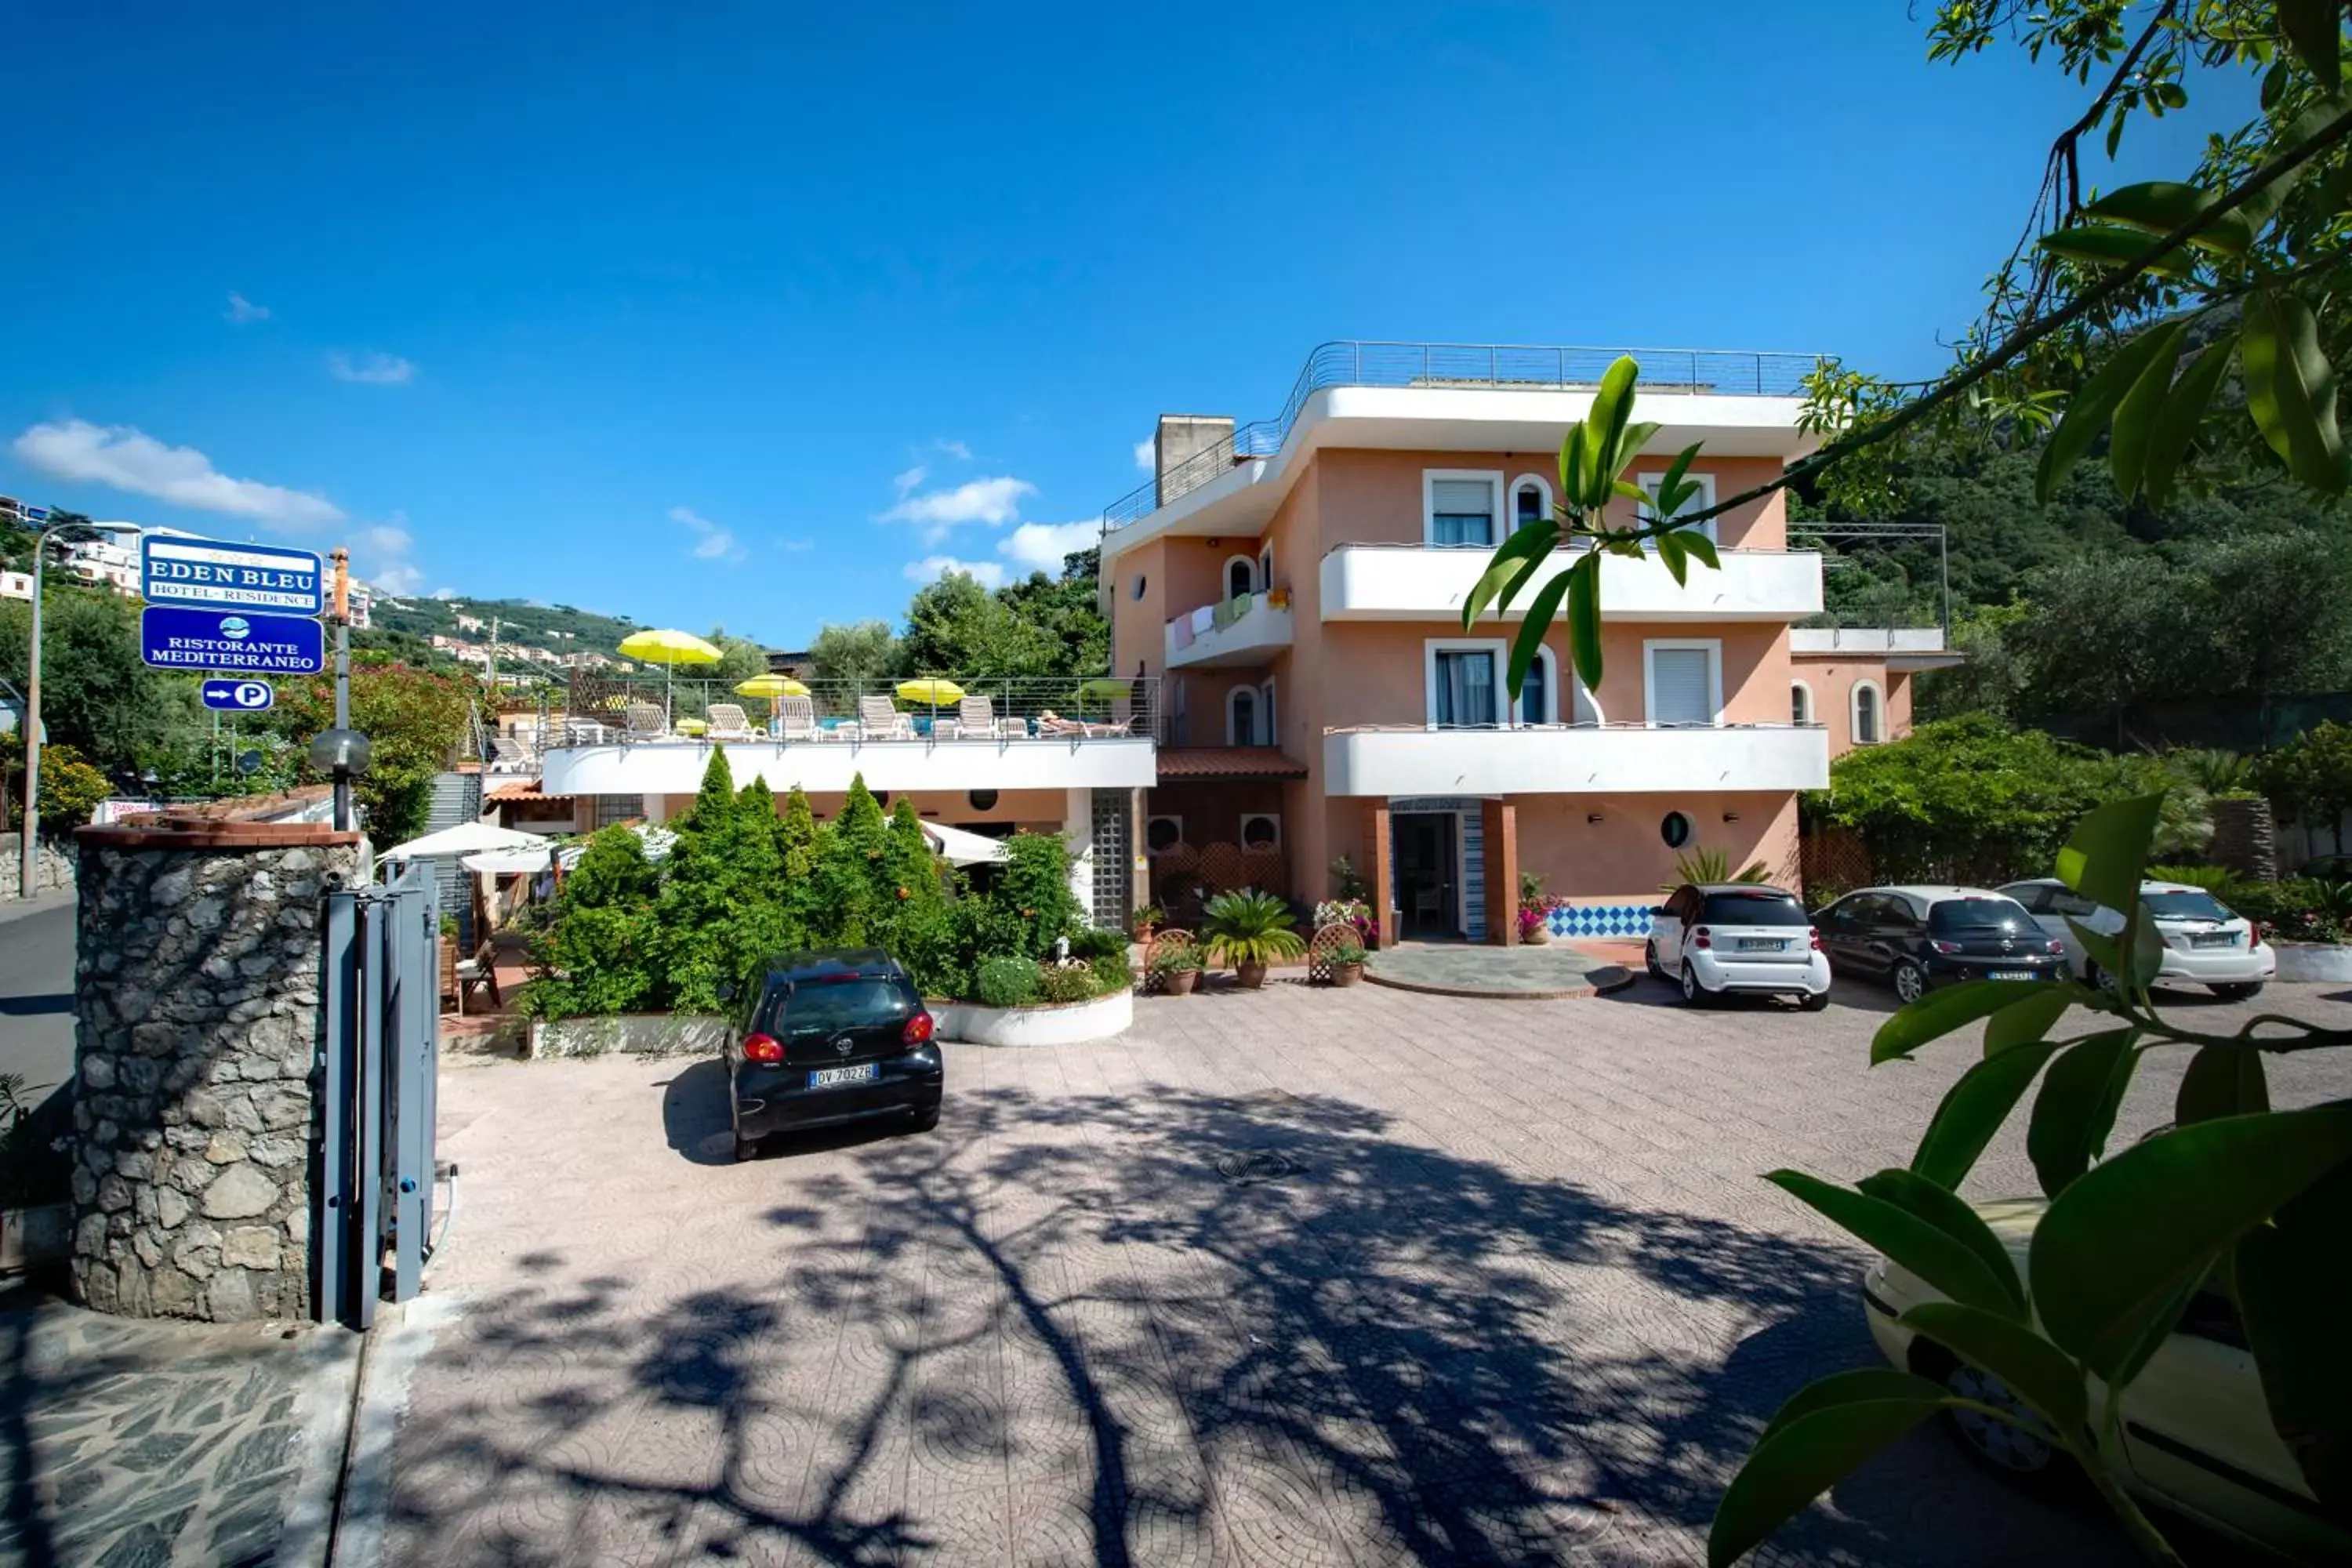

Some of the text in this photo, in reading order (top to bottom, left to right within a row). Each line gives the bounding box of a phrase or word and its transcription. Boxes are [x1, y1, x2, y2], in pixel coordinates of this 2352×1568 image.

[148, 561, 314, 590] EDEN BLEU
[224, 590, 314, 605] RESIDENCE
[169, 637, 298, 655] RISTORANTE
[151, 649, 314, 669] MEDITERRANEO
[244, 687, 261, 702] P
